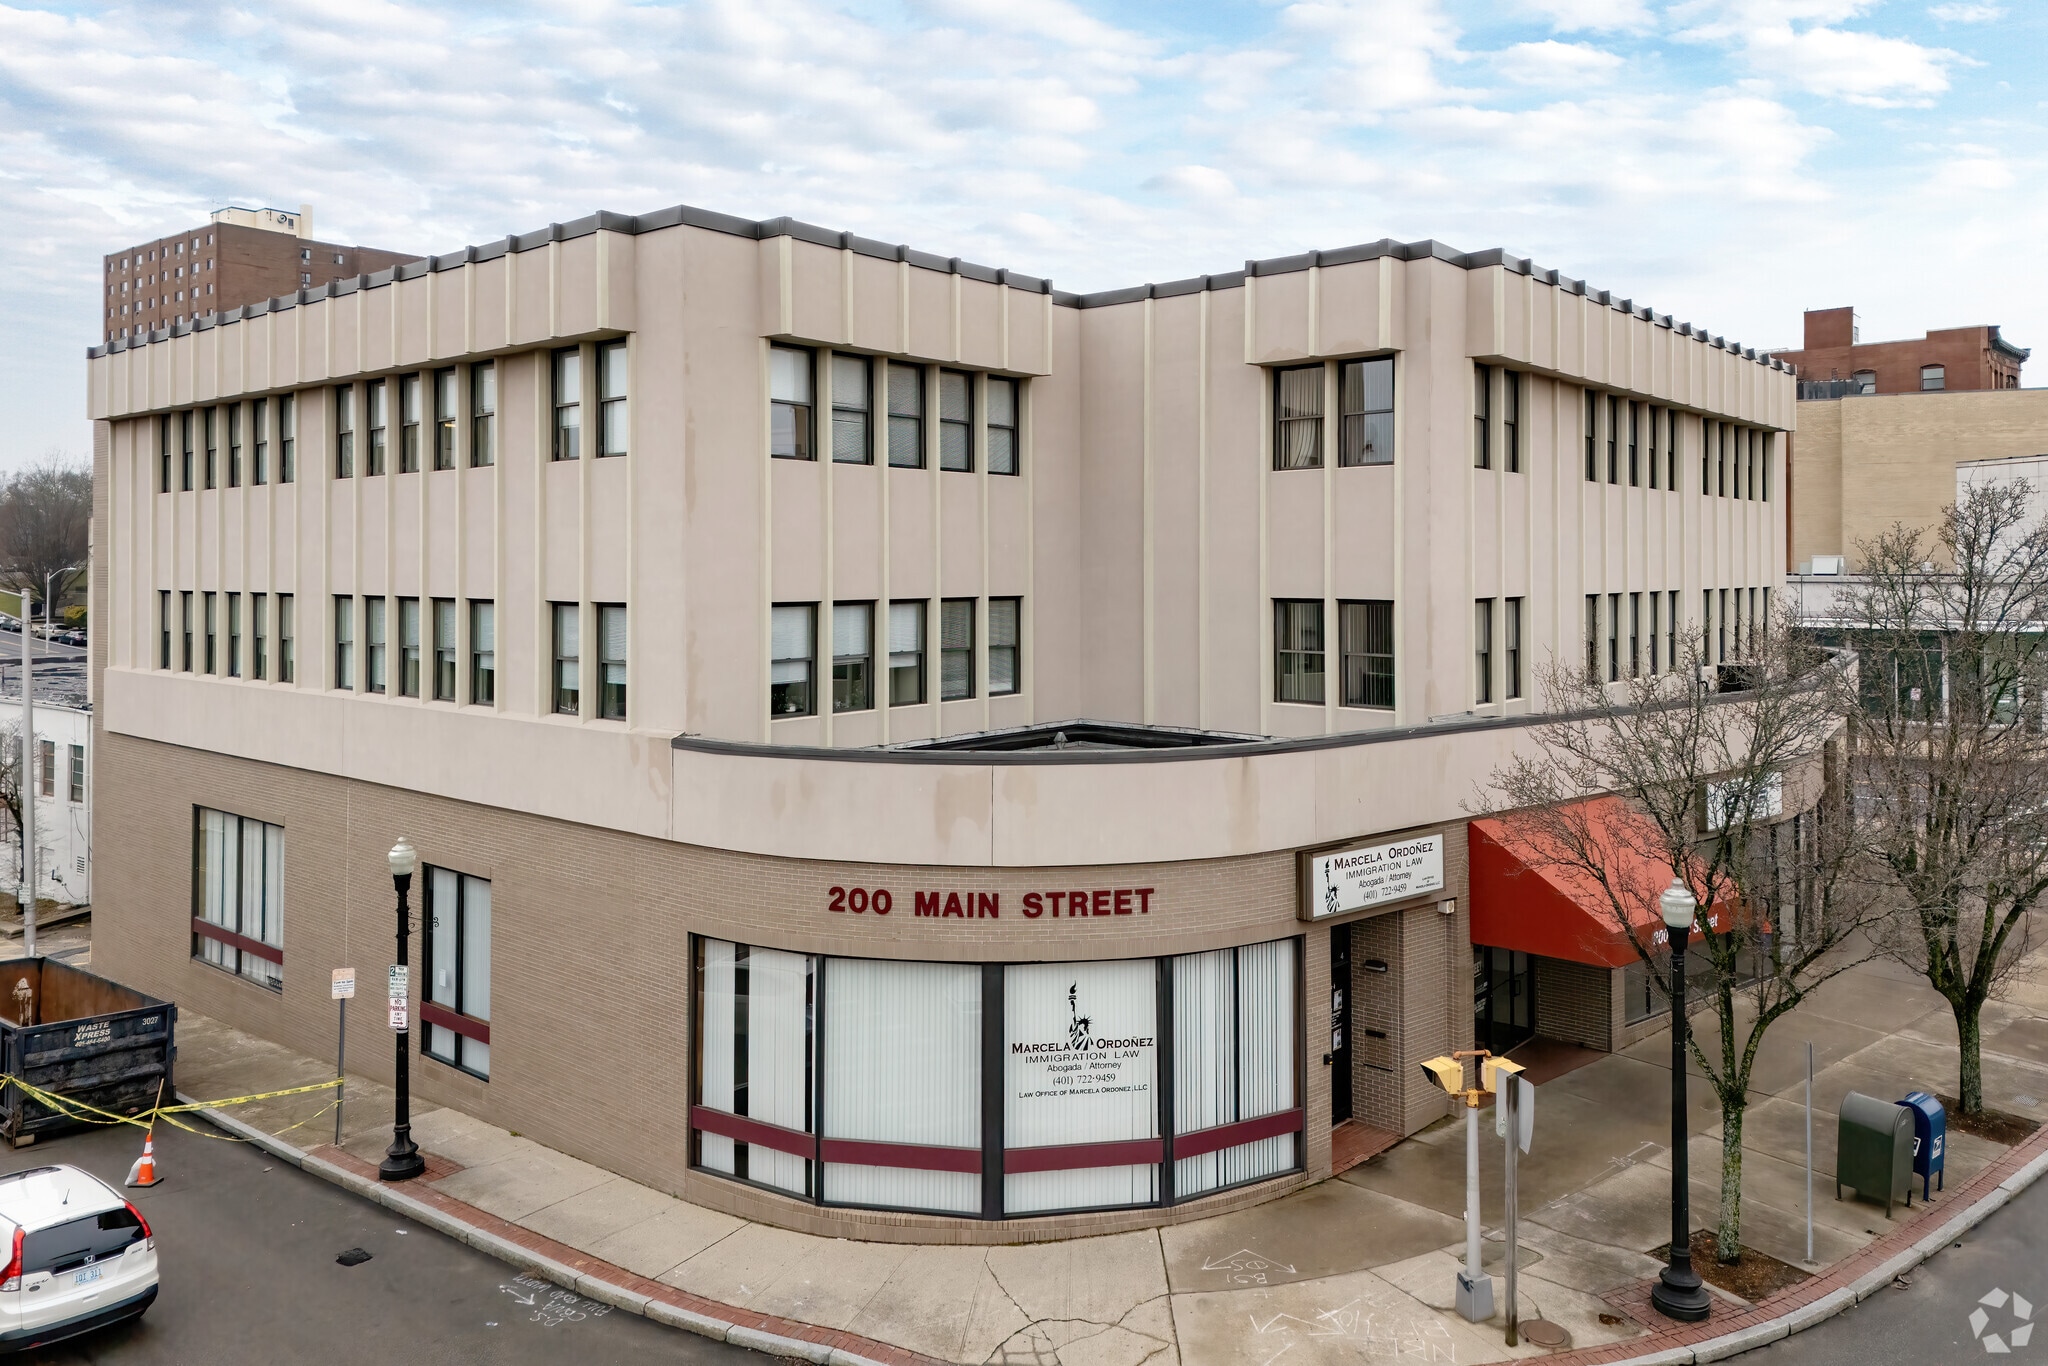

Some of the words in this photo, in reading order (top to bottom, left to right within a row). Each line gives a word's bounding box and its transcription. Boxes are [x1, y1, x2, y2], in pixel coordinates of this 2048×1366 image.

[1334, 852, 1382, 871] MARCELA
[1388, 842, 1433, 859] ORDOÑEZ
[1346, 862, 1401, 880] IMMIGRATION
[1406, 856, 1423, 867] LAW
[1358, 876, 1384, 888] Abogada
[1389, 871, 1412, 883] Attorney
[828, 886, 892, 915] 200
[914, 891, 999, 918] MAIN
[1022, 888, 1154, 918] STREET
[1363, 889, 1378, 903] (401)
[77, 1021, 110, 1033] WASTE
[142, 1016, 159, 1026] 3027
[74, 1028, 111, 1041] XPRESS
[1012, 1042, 1071, 1054] MARCELA
[1096, 1036, 1154, 1050] ORDOÑEZ
[1025, 1051, 1107, 1064] IMMIGRATION
[1114, 1050, 1140, 1059] LAW
[1047, 1063, 1082, 1073] Abogada
[1089, 1061, 1122, 1071] Attorney
[1052, 1075, 1074, 1086] (401)
[1018, 1091, 1034, 1099] LAW
[1035, 1089, 1058, 1098] OFFICE
[1069, 1087, 1100, 1095] MARCELA
